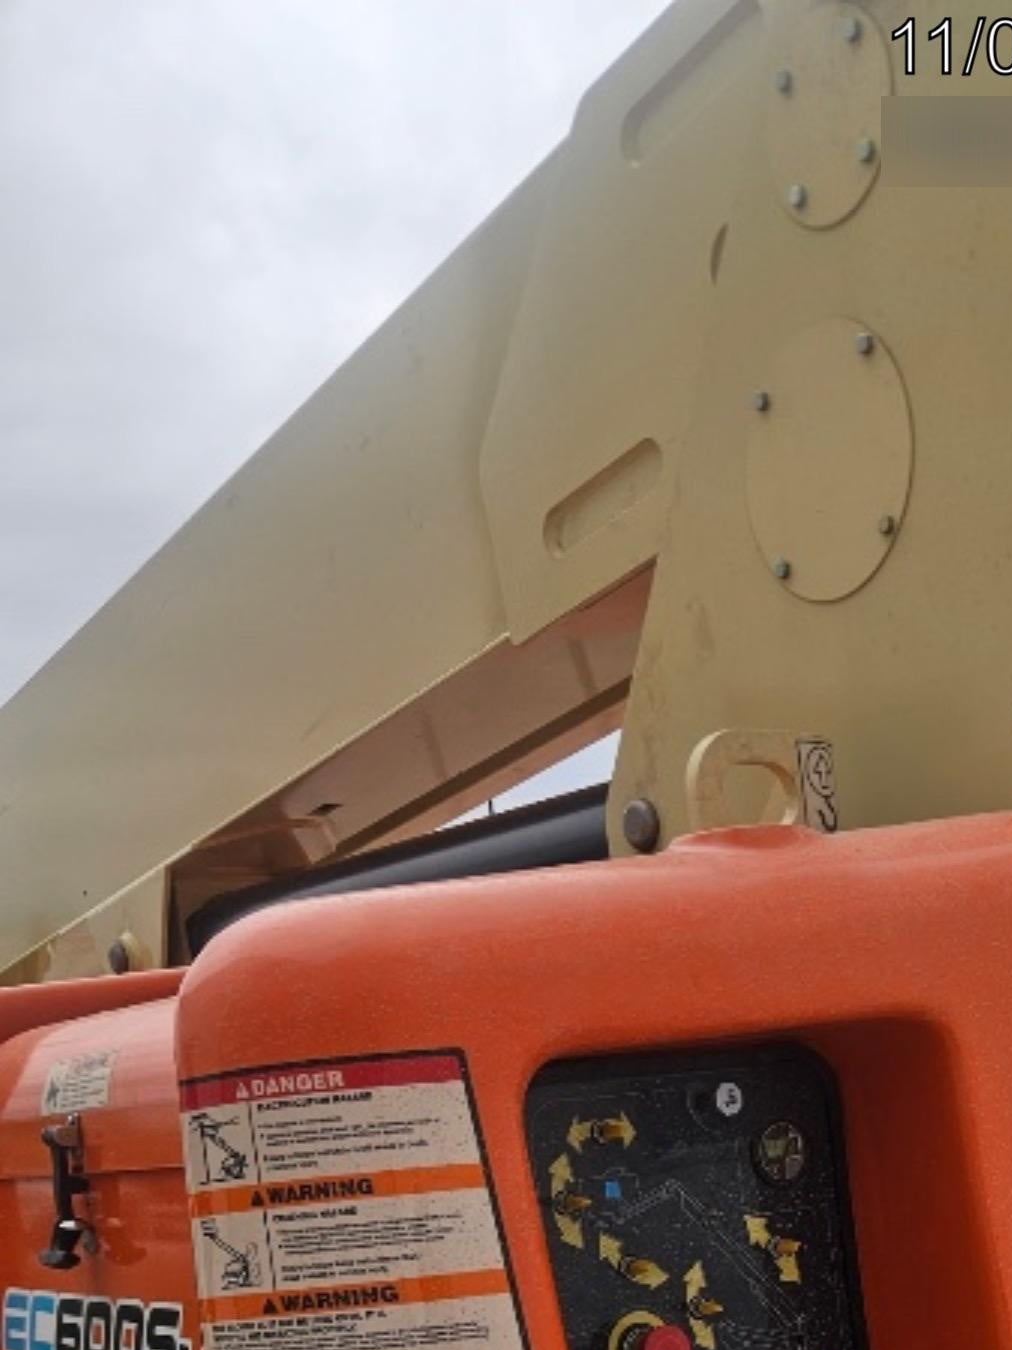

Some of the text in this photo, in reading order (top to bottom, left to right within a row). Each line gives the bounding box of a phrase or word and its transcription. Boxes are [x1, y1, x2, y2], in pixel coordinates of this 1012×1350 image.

[251, 1070, 344, 1097] DANGER
[266, 1178, 374, 1203] WARNING
[279, 1285, 399, 1312] WARNING
